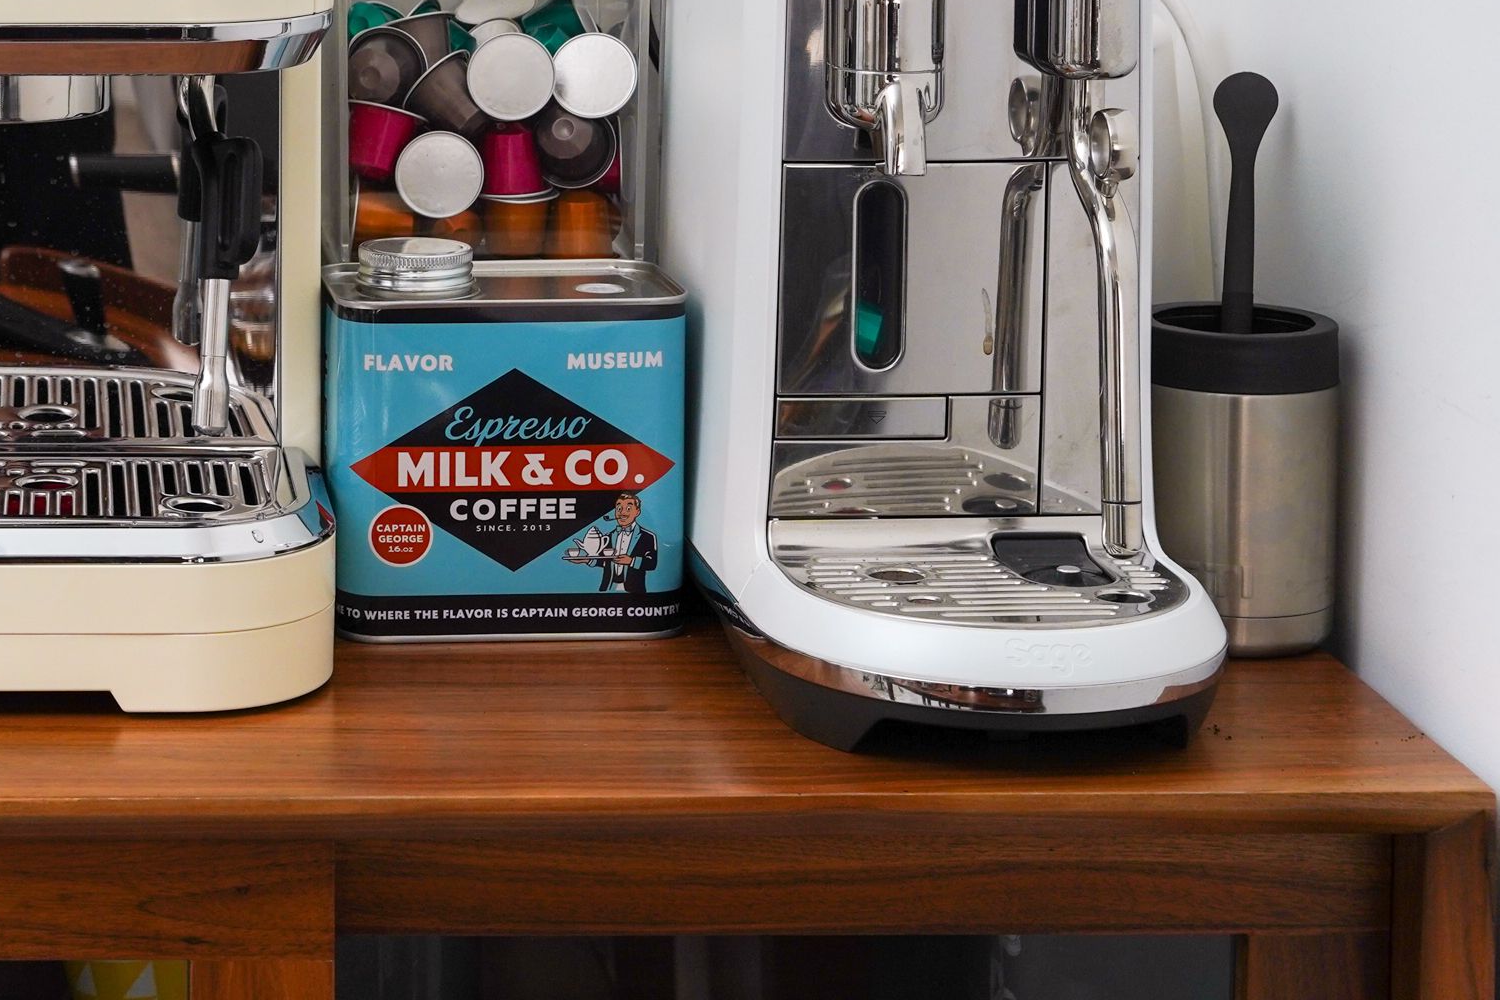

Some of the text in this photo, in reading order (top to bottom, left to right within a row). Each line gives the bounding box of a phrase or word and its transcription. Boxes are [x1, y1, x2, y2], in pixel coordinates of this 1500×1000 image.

[364, 354, 453, 371] FLAVOR
[567, 351, 663, 370] MUSEUM
[444, 406, 592, 447] Espresso
[397, 449, 645, 488] MILK & CO.
[449, 498, 577, 521] COFFEE
[376, 523, 426, 533] CAPTAIN
[475, 524, 551, 532] SINCE. 2013
[378, 534, 424, 544] GEORGE
[346, 607, 361, 619] TO
[364, 610, 410, 620] WHERE
[414, 610, 439, 620] THE
[443, 608, 493, 619] FLAVOR
[496, 607, 508, 618] IS
[512, 607, 568, 618] CAPTAIN
[572, 607, 623, 617] GEORGE
[627, 603, 680, 617] COUNTRY
[1004, 638, 1093, 678] Sage
